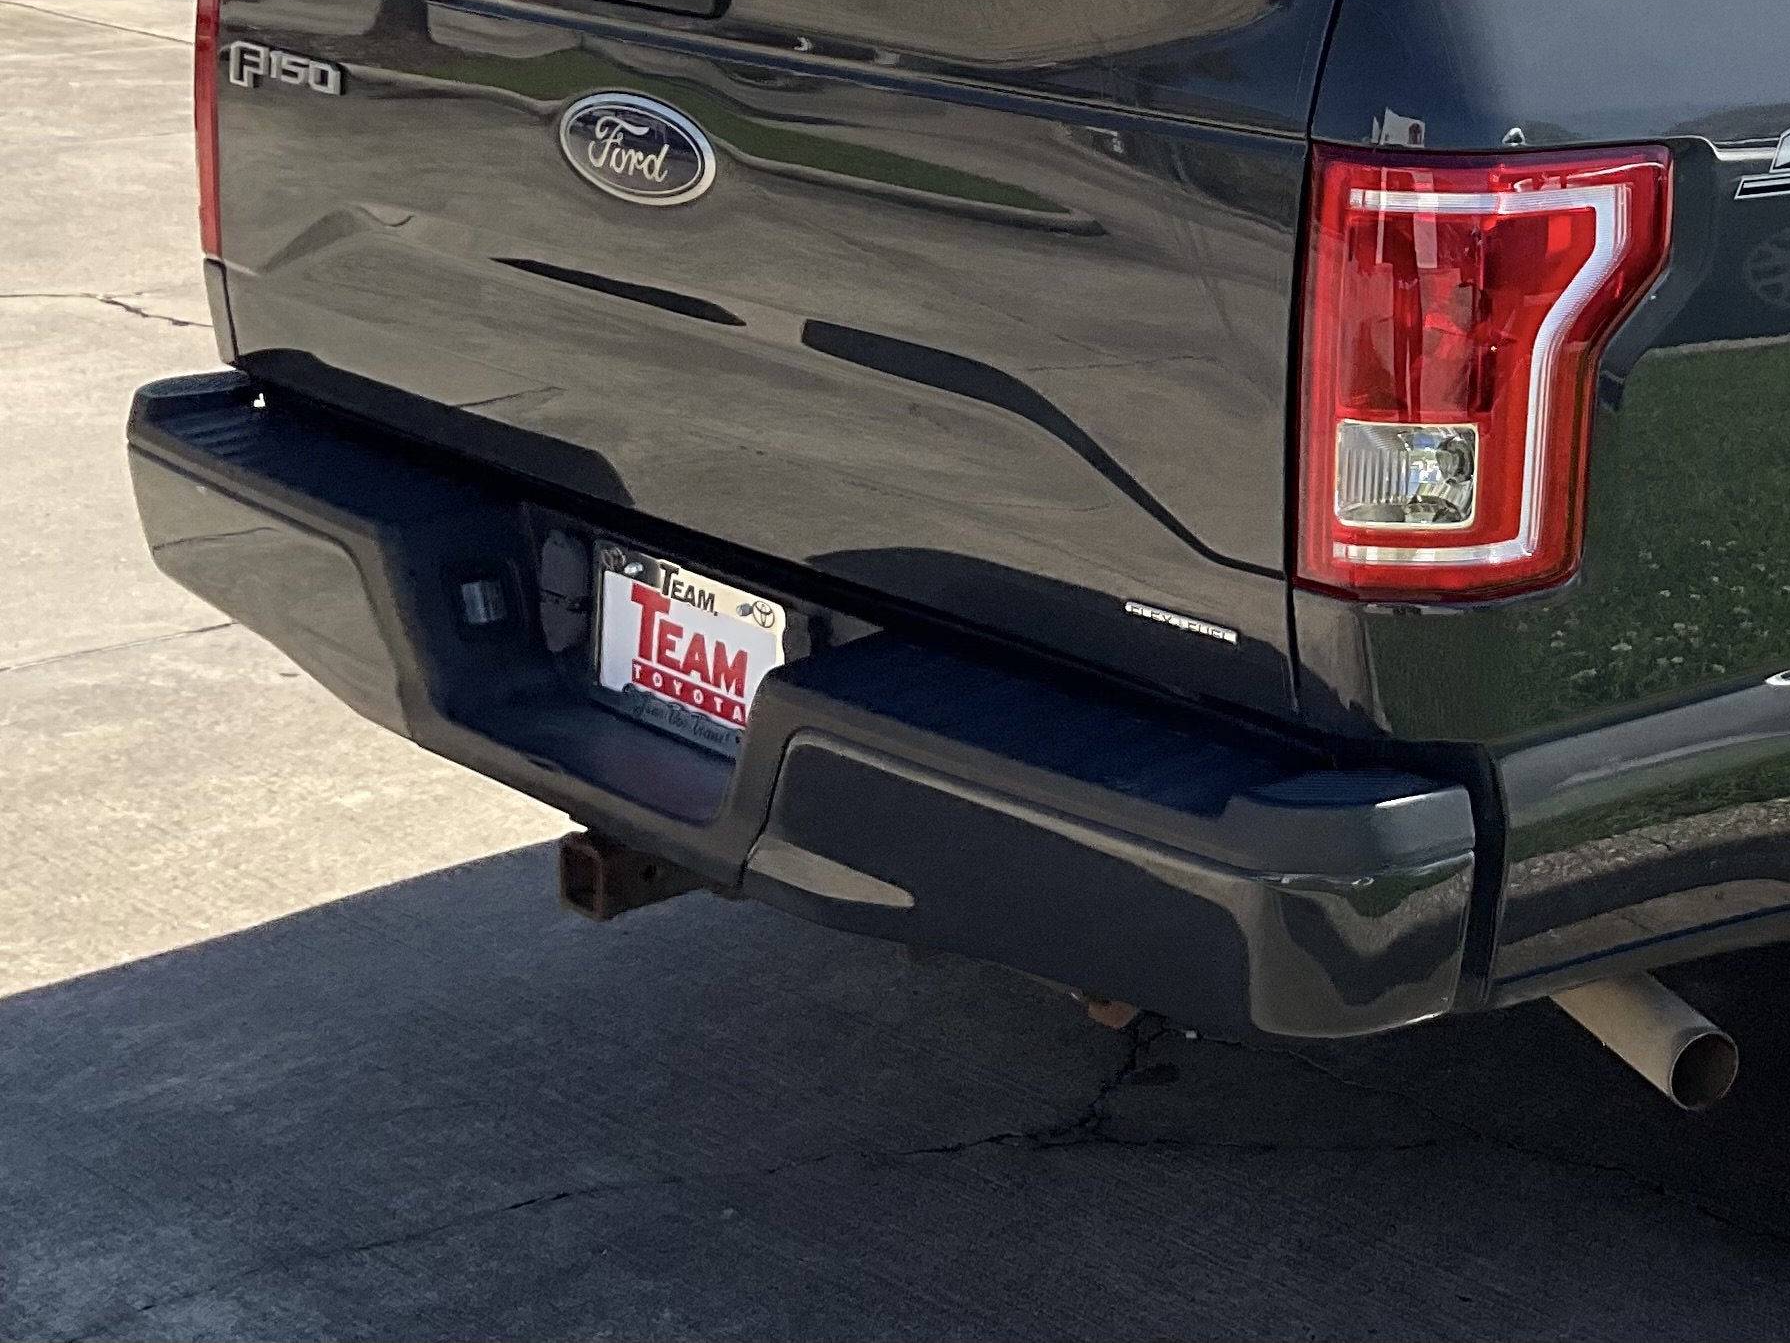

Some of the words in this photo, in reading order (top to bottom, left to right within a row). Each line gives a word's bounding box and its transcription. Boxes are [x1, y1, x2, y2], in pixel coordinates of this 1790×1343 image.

[587, 115, 671, 183] Ford
[631, 580, 748, 698] TEAM
[633, 663, 744, 722] TOYOTA
